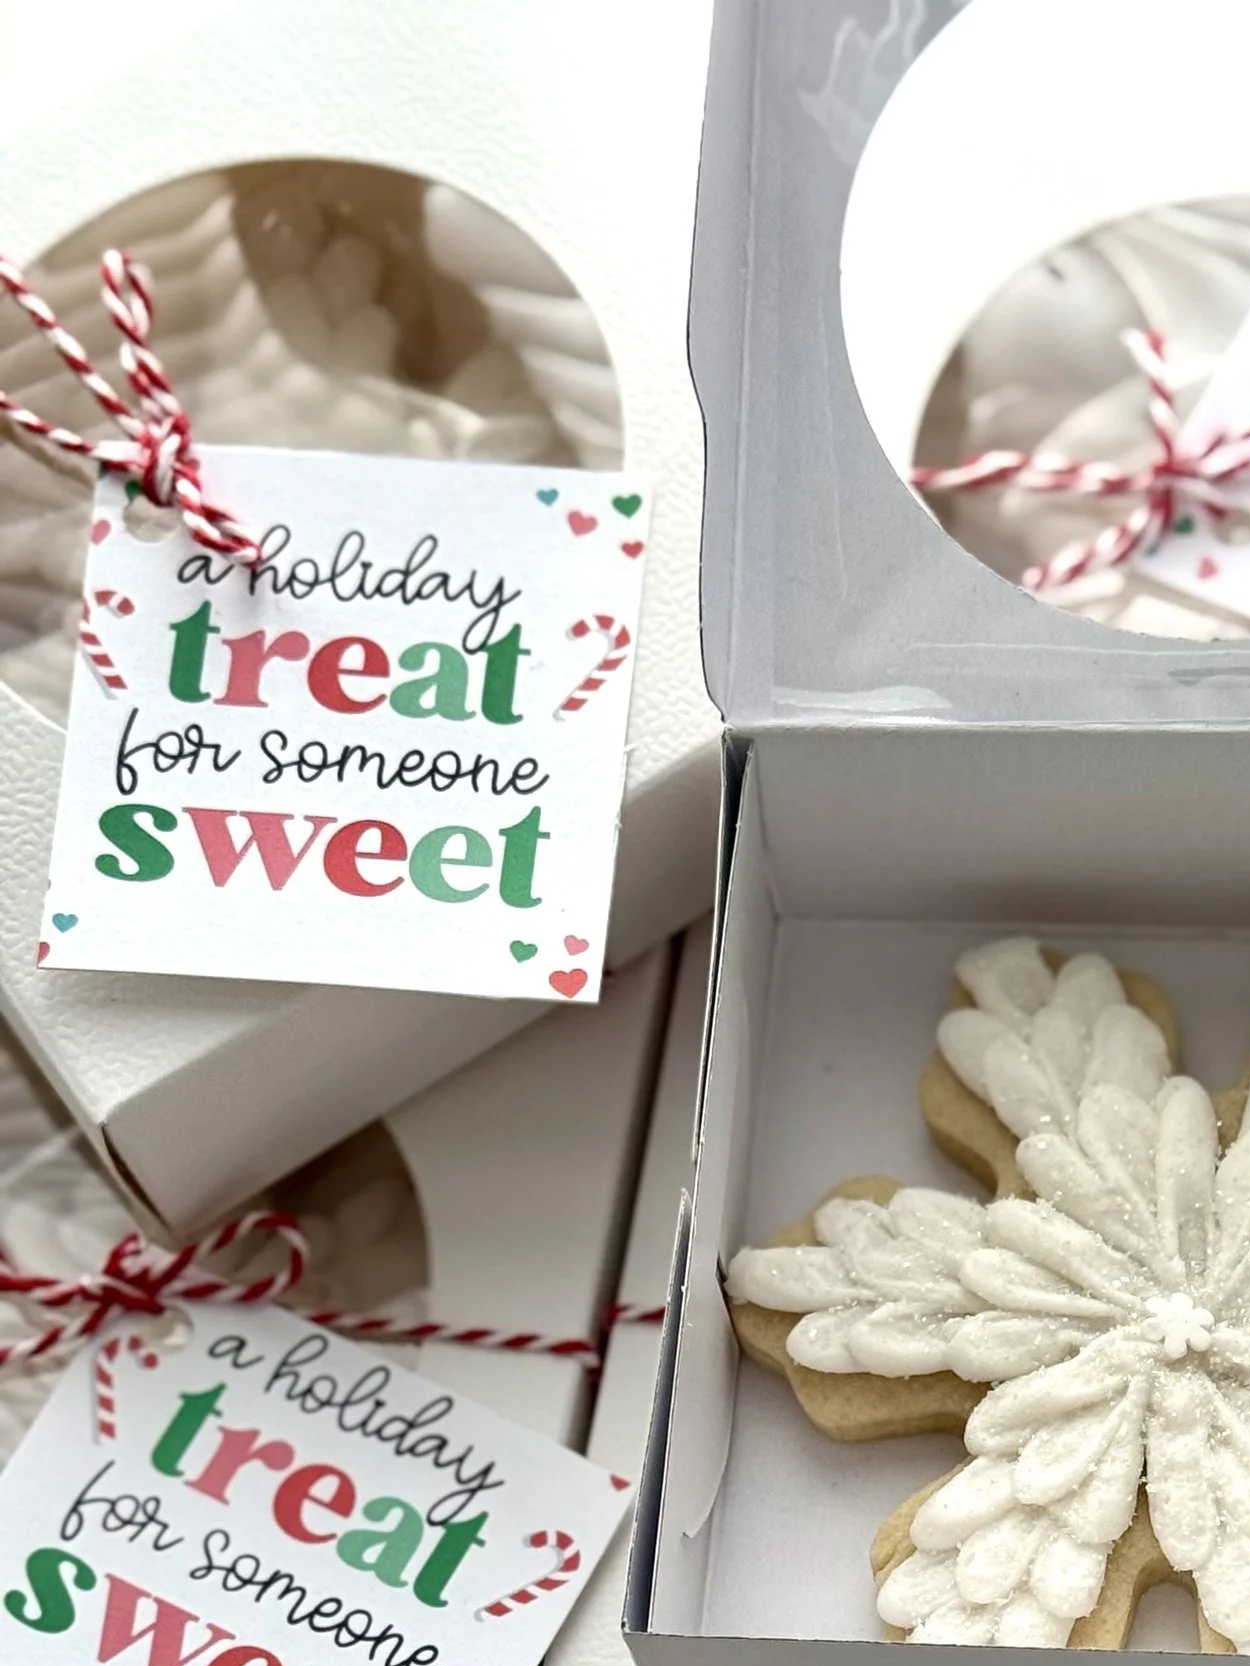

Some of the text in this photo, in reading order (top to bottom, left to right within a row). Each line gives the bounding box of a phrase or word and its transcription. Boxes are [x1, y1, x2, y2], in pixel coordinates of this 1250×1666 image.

[176, 524, 522, 655] a holiday
[168, 600, 532, 725] treat
[115, 707, 550, 796] for someone
[94, 802, 551, 909] sweet
[207, 1334, 505, 1528] a holiday
[60, 1461, 184, 1552] for
[149, 1382, 490, 1609] treat
